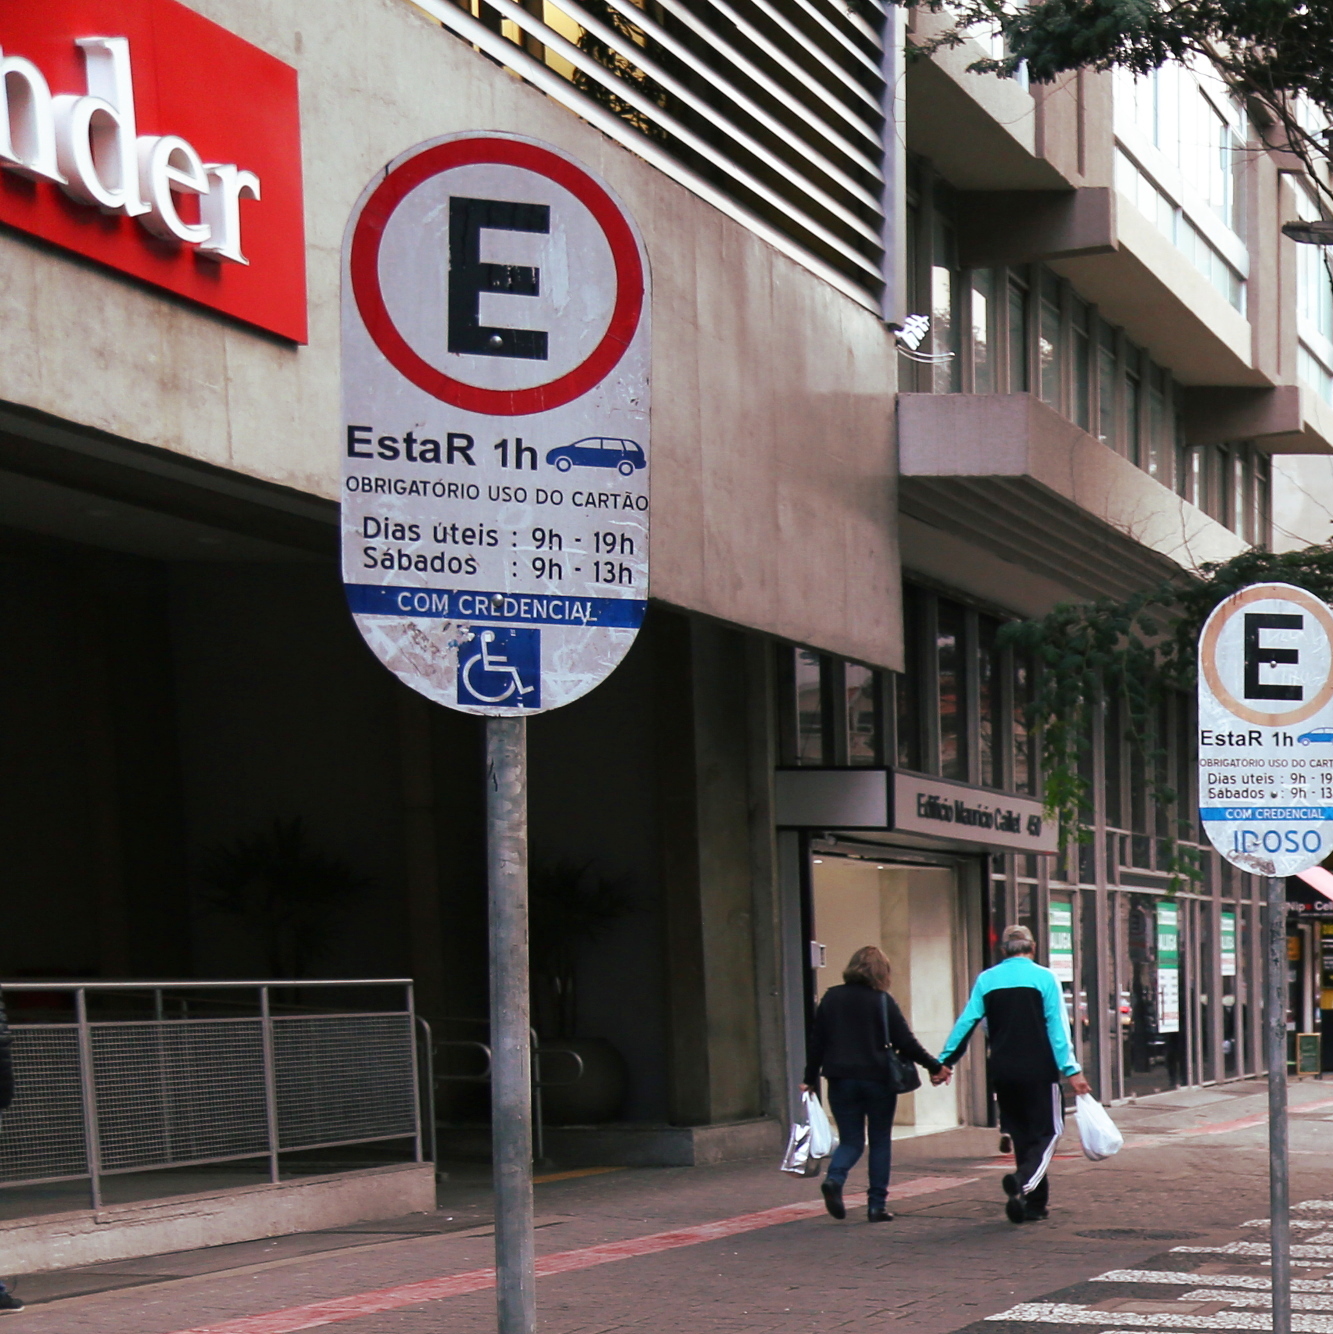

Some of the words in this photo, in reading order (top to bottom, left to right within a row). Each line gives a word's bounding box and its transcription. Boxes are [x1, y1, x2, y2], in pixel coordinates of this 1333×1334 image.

[0, 37, 261, 266] nder
[447, 196, 550, 360] E
[346, 425, 476, 466] EstaR
[494, 438, 538, 471] 1h
[346, 475, 480, 500] OBRIGATÓRIO
[488, 486, 528, 504] USO
[536, 489, 564, 506] DO
[572, 491, 649, 512] CARTÃO
[363, 516, 421, 542] Dias
[433, 522, 499, 547] úteis
[532, 528, 563, 551] 9h
[593, 531, 635, 555] 19h
[363, 547, 477, 576] Sábados
[532, 557, 563, 580] 9h
[593, 561, 634, 585] 13h
[398, 592, 449, 614] COM
[458, 596, 597, 621] CREDENCIAL
[1244, 613, 1303, 701] E
[1201, 730, 1263, 746] EstaR
[1272, 732, 1294, 747] 1h
[1208, 773, 1237, 785] Dias
[1241, 772, 1274, 785] úteis
[1290, 773, 1306, 785] 9h
[1269, 759, 1289, 768] USO
[1291, 759, 1306, 768] DO
[1208, 787, 1265, 799] Sábados
[1290, 788, 1306, 799] 9h
[1225, 808, 1252, 819] COM
[1255, 808, 1325, 819] CREDENCIAL
[1234, 830, 1322, 853] IDOSO
